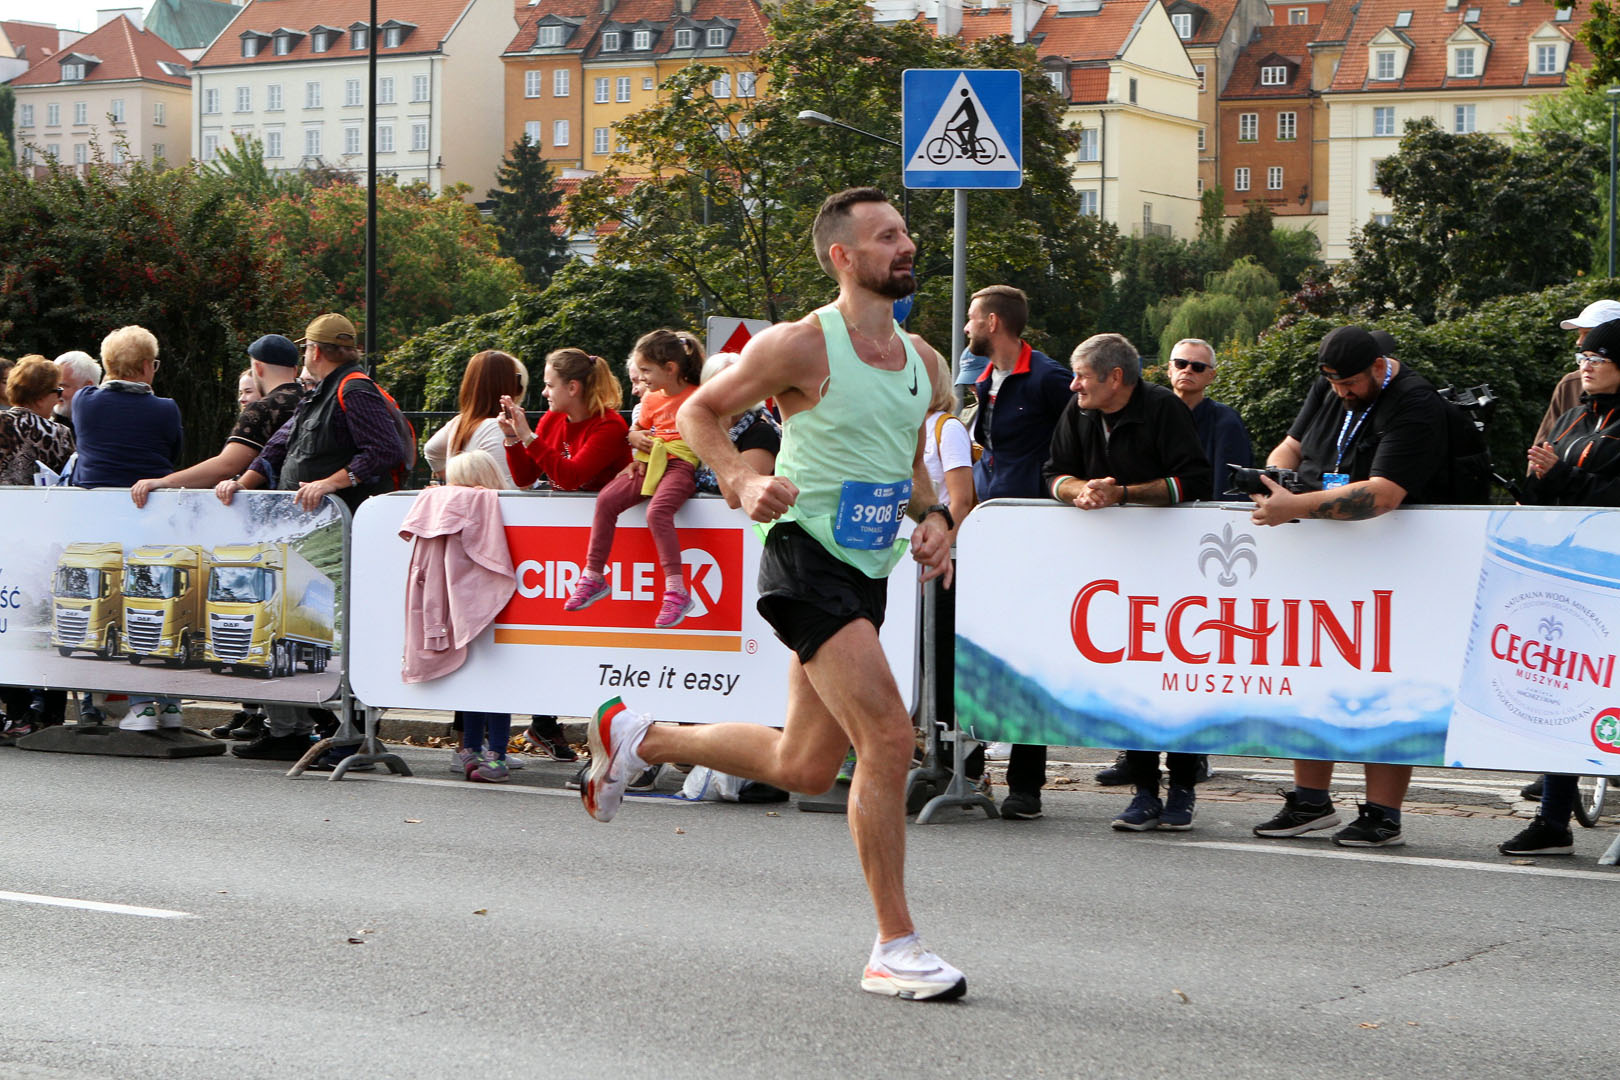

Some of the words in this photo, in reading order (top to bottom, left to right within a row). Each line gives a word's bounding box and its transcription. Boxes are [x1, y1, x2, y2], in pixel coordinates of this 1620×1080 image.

[851, 504, 893, 524] 3908
[516, 559, 655, 601] CIRLE
[1545, 592, 1570, 604] WODA
[1070, 579, 1394, 673] CECHINI
[1490, 623, 1617, 689] CECHINI
[598, 663, 651, 688] Take
[658, 665, 676, 689] it
[683, 671, 740, 696] easy
[1162, 672, 1293, 696] MUSZYNA
[1516, 668, 1569, 691] MUSZYNA
